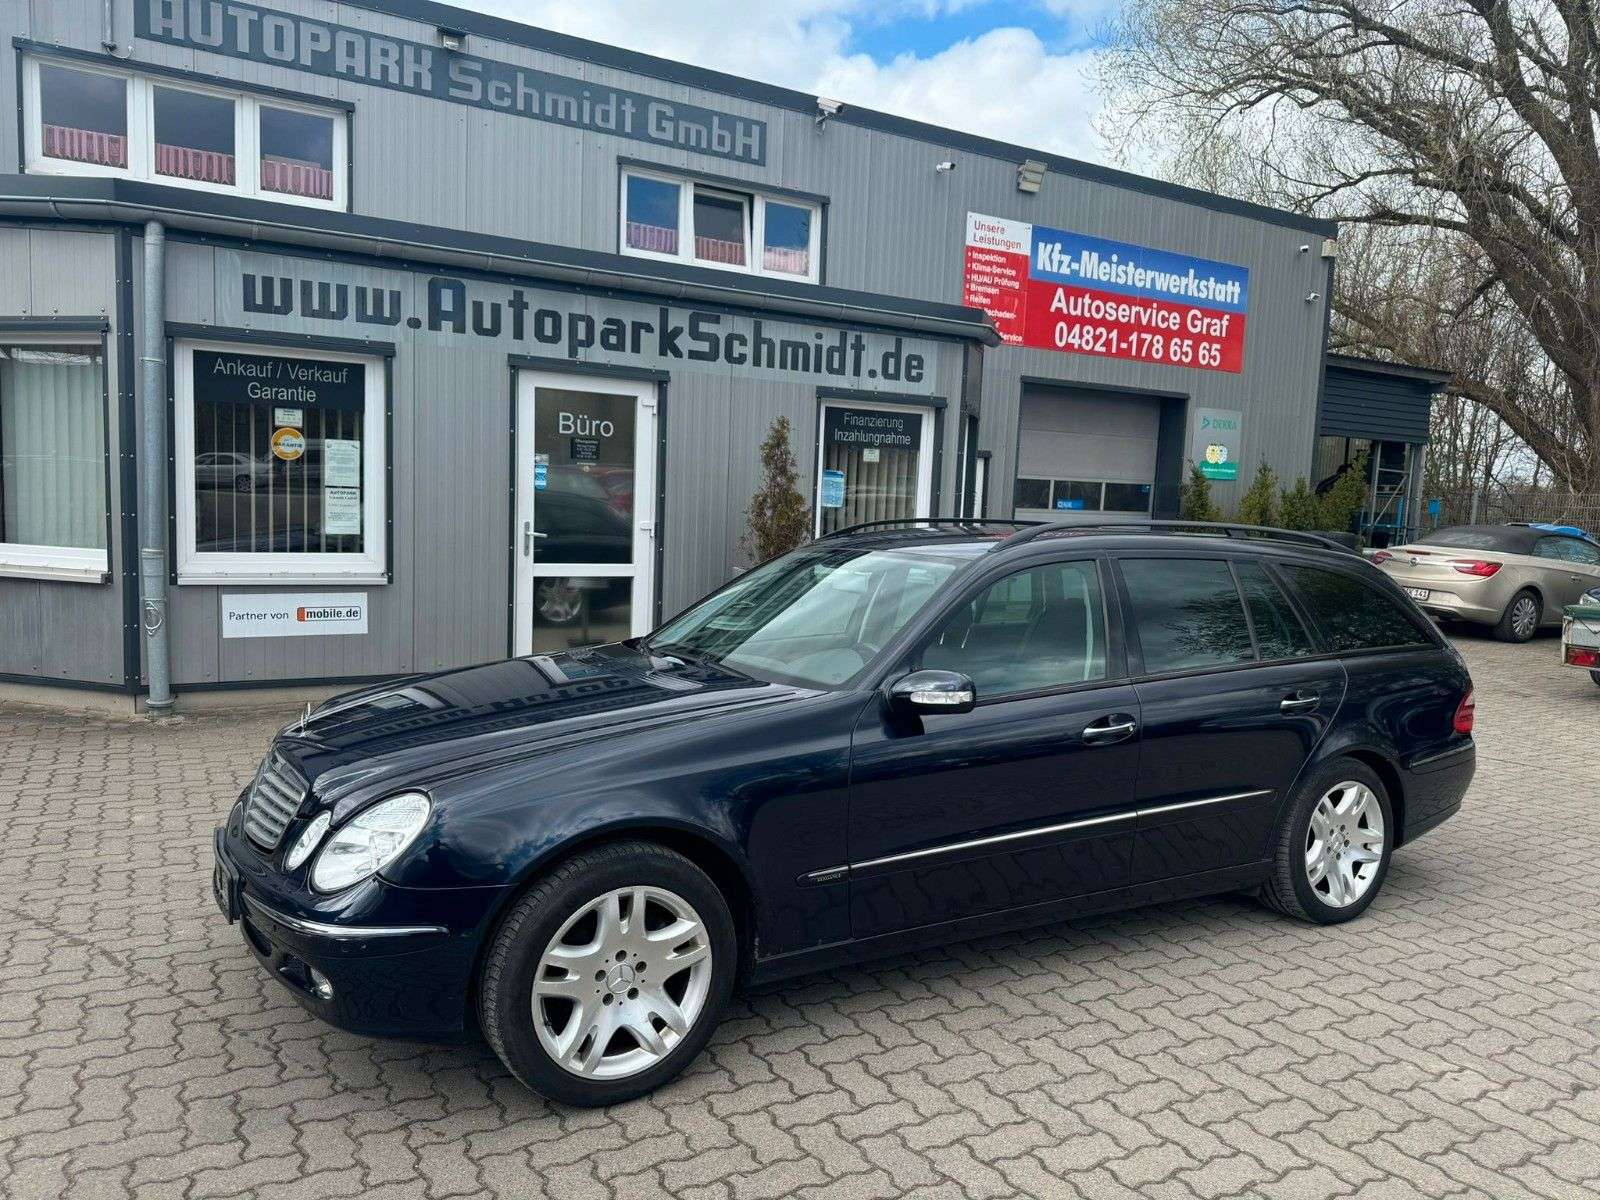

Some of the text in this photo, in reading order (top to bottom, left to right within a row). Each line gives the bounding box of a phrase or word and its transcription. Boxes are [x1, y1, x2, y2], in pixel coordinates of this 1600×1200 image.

[151, 0, 760, 161] AUTOPARK Schmidt GmbH
[974, 220, 1006, 235] Unsere
[973, 233, 1022, 250] Leistungen
[972, 250, 1006, 263] Inspektion
[971, 262, 1016, 276] Klima-Service
[1037, 242, 1240, 304] Kfz-Meisterwerkstatt
[970, 283, 999, 294] Bremsen
[969, 294, 991, 305] Reifen
[1049, 287, 1230, 338] Autoservice Graf
[242, 273, 926, 384] www.AutoparkSchmidt.de
[1054, 321, 1222, 367] 04821-178 65 65
[213, 357, 349, 384] Ankauf / Verkauf
[247, 381, 317, 403] Garantie
[558, 412, 614, 437] Büro
[843, 413, 904, 431] Finanzierung
[834, 428, 912, 446] Inzahlungnahme
[228, 608, 359, 622] Partner von mobile.de
